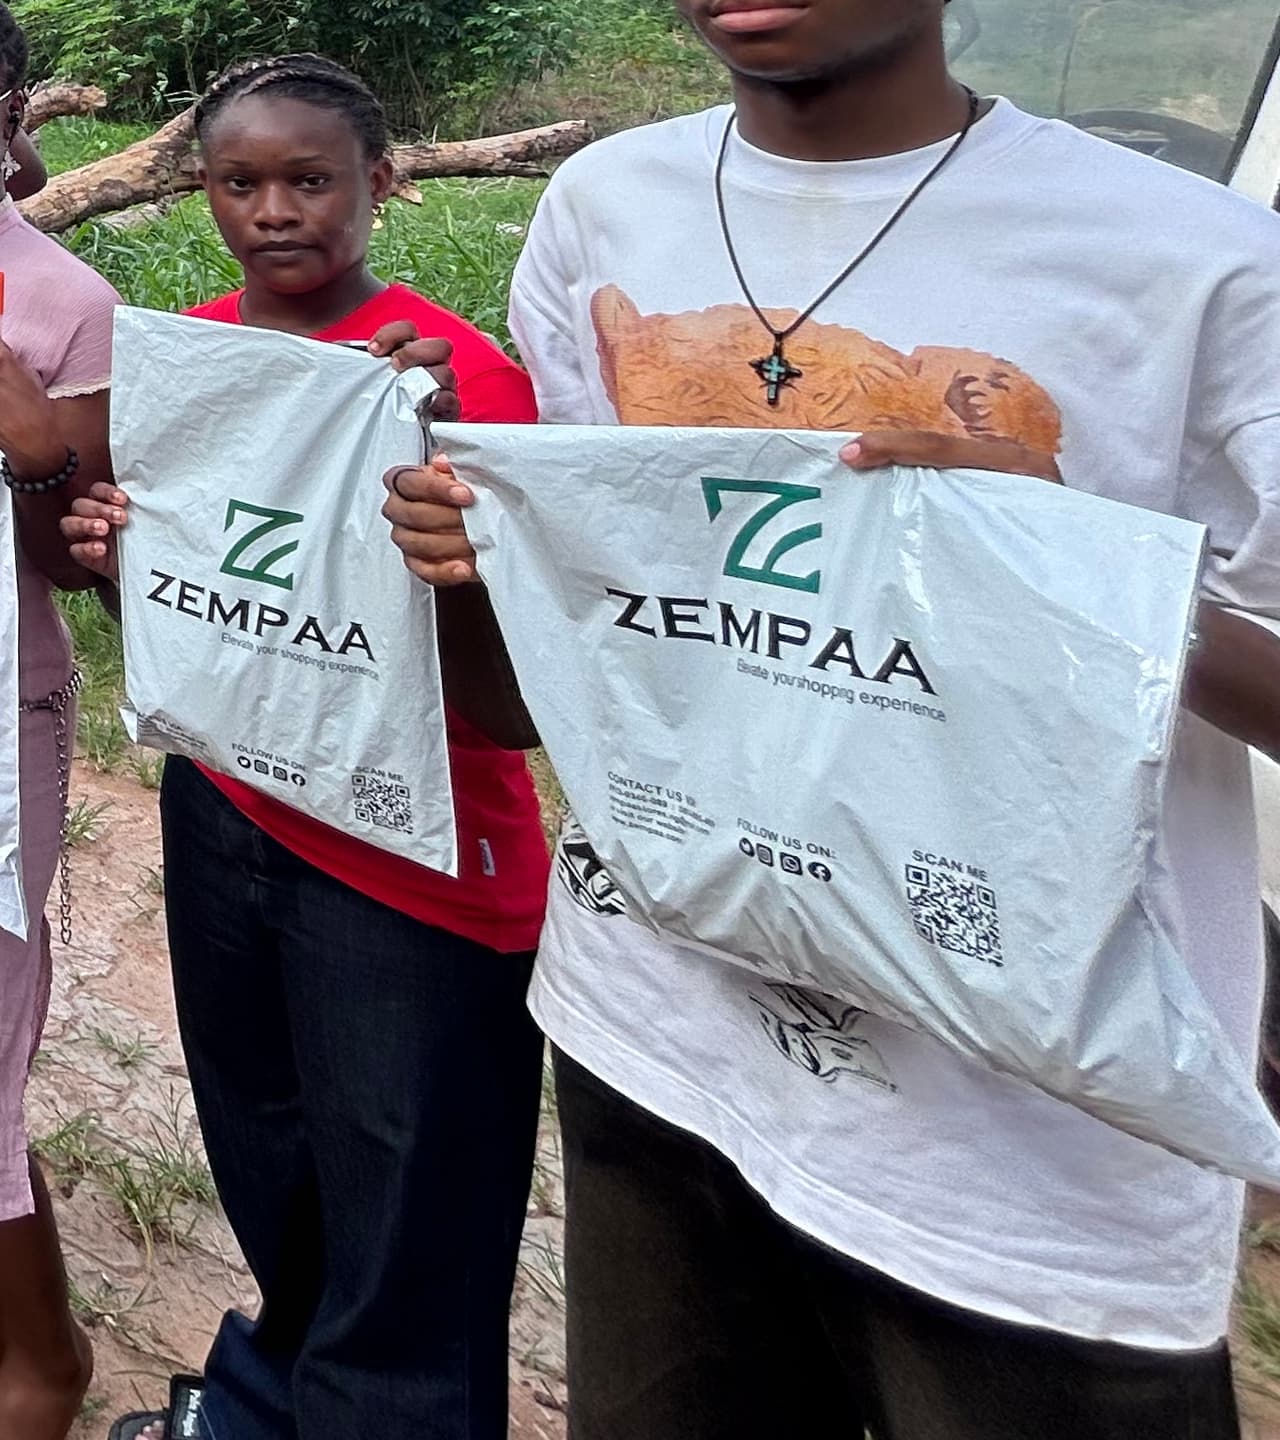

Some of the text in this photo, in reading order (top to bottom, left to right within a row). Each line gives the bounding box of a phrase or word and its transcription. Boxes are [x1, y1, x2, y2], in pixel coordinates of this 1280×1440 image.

[146, 568, 377, 663] ZEMPAA
[603, 585, 940, 696] ZEMPAA
[255, 642, 279, 656] your
[281, 649, 327, 672] shopping
[858, 691, 947, 723] experience
[231, 742, 274, 761] FOLLOW
[355, 765, 405, 782] SCAN ME
[608, 771, 663, 795] CONTACT
[666, 788, 683, 802] US
[737, 817, 779, 843] FOLLOW
[782, 834, 803, 850] US
[911, 849, 989, 883] SCAN ME
